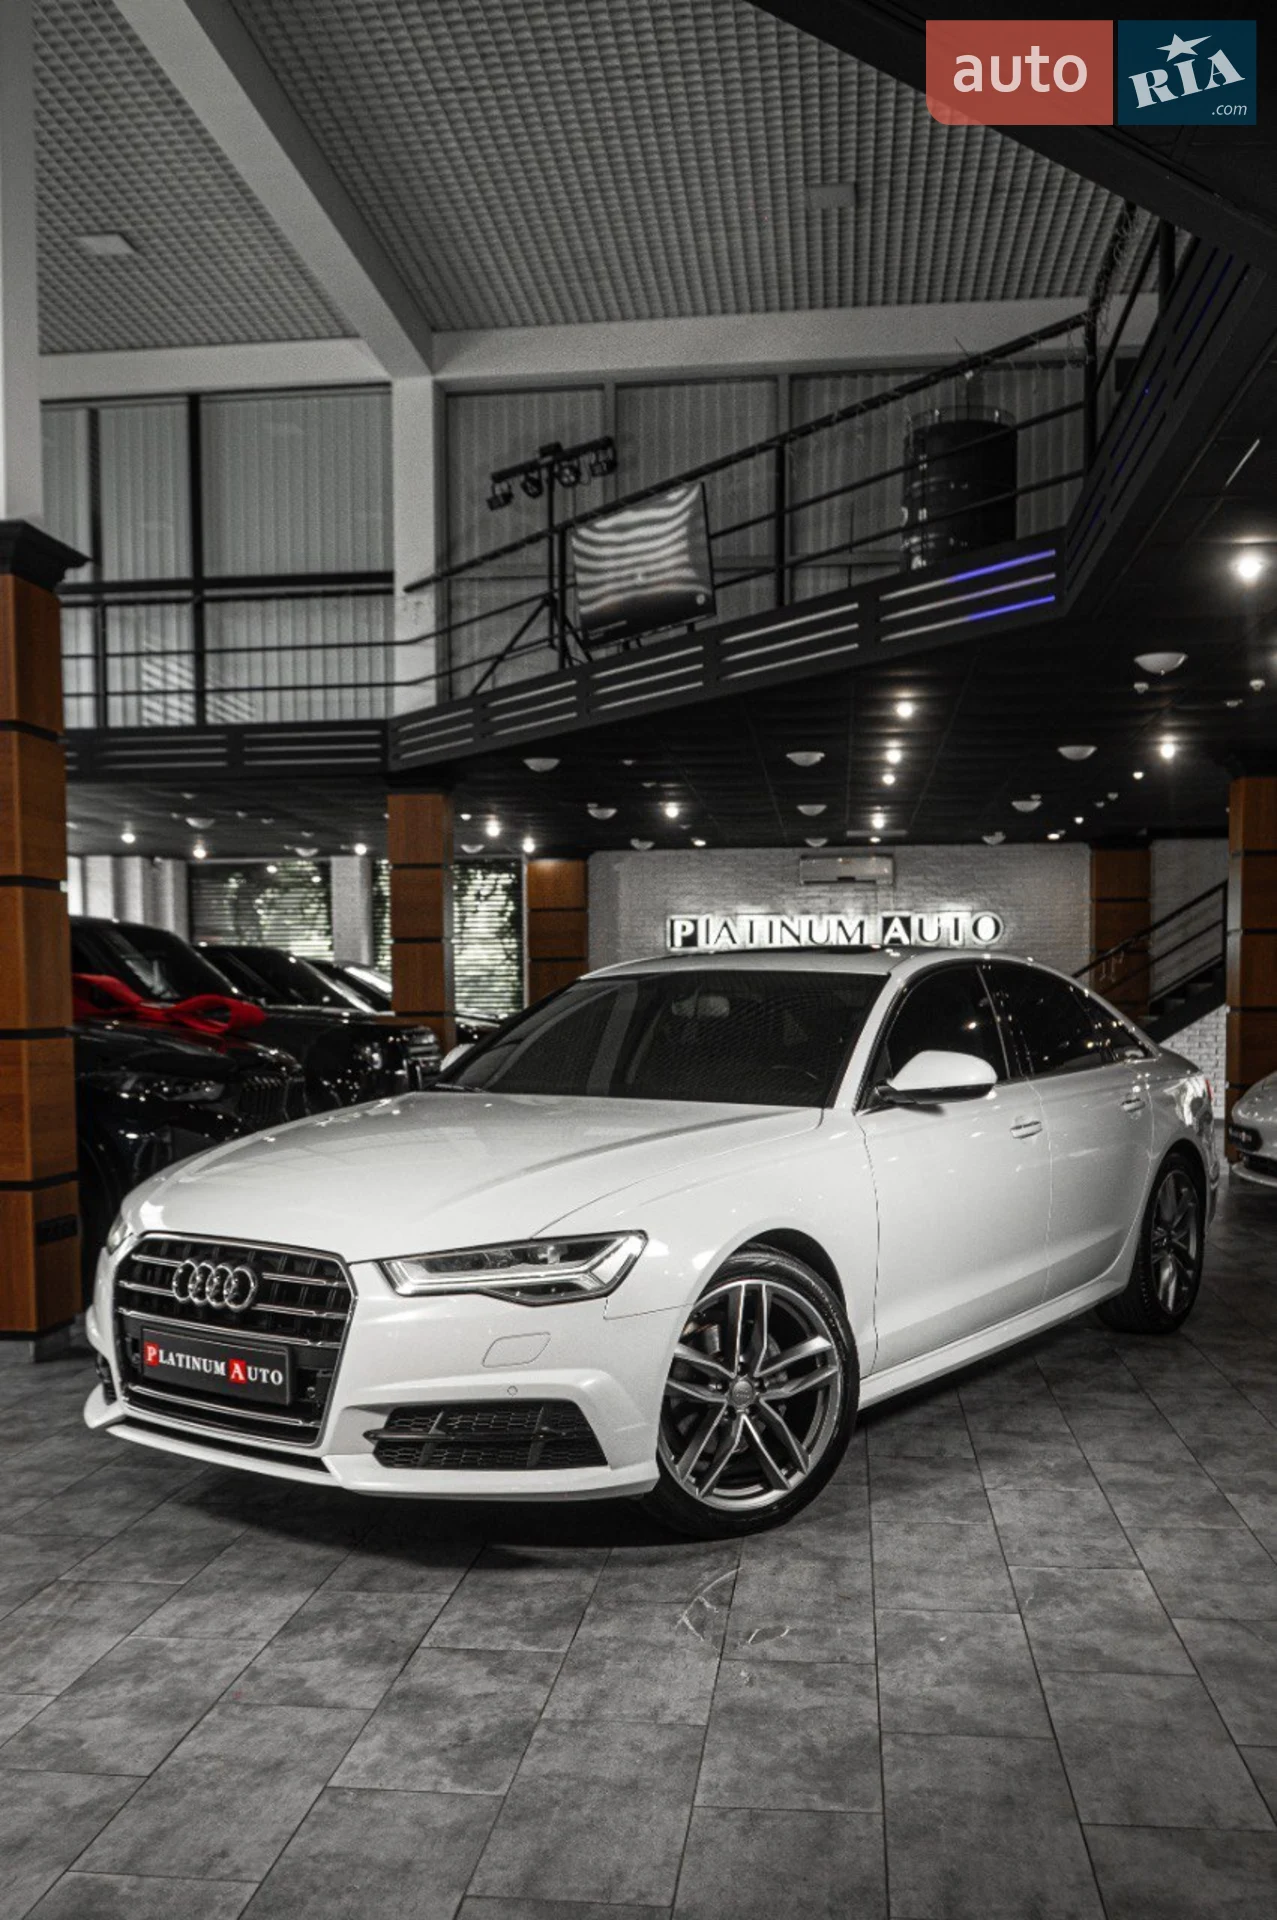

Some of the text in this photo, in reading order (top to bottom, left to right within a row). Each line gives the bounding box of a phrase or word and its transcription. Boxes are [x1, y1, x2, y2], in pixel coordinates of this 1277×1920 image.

[882, 914, 1003, 946] AUTO
[146, 1344, 284, 1385] PLATINUM AUTO
